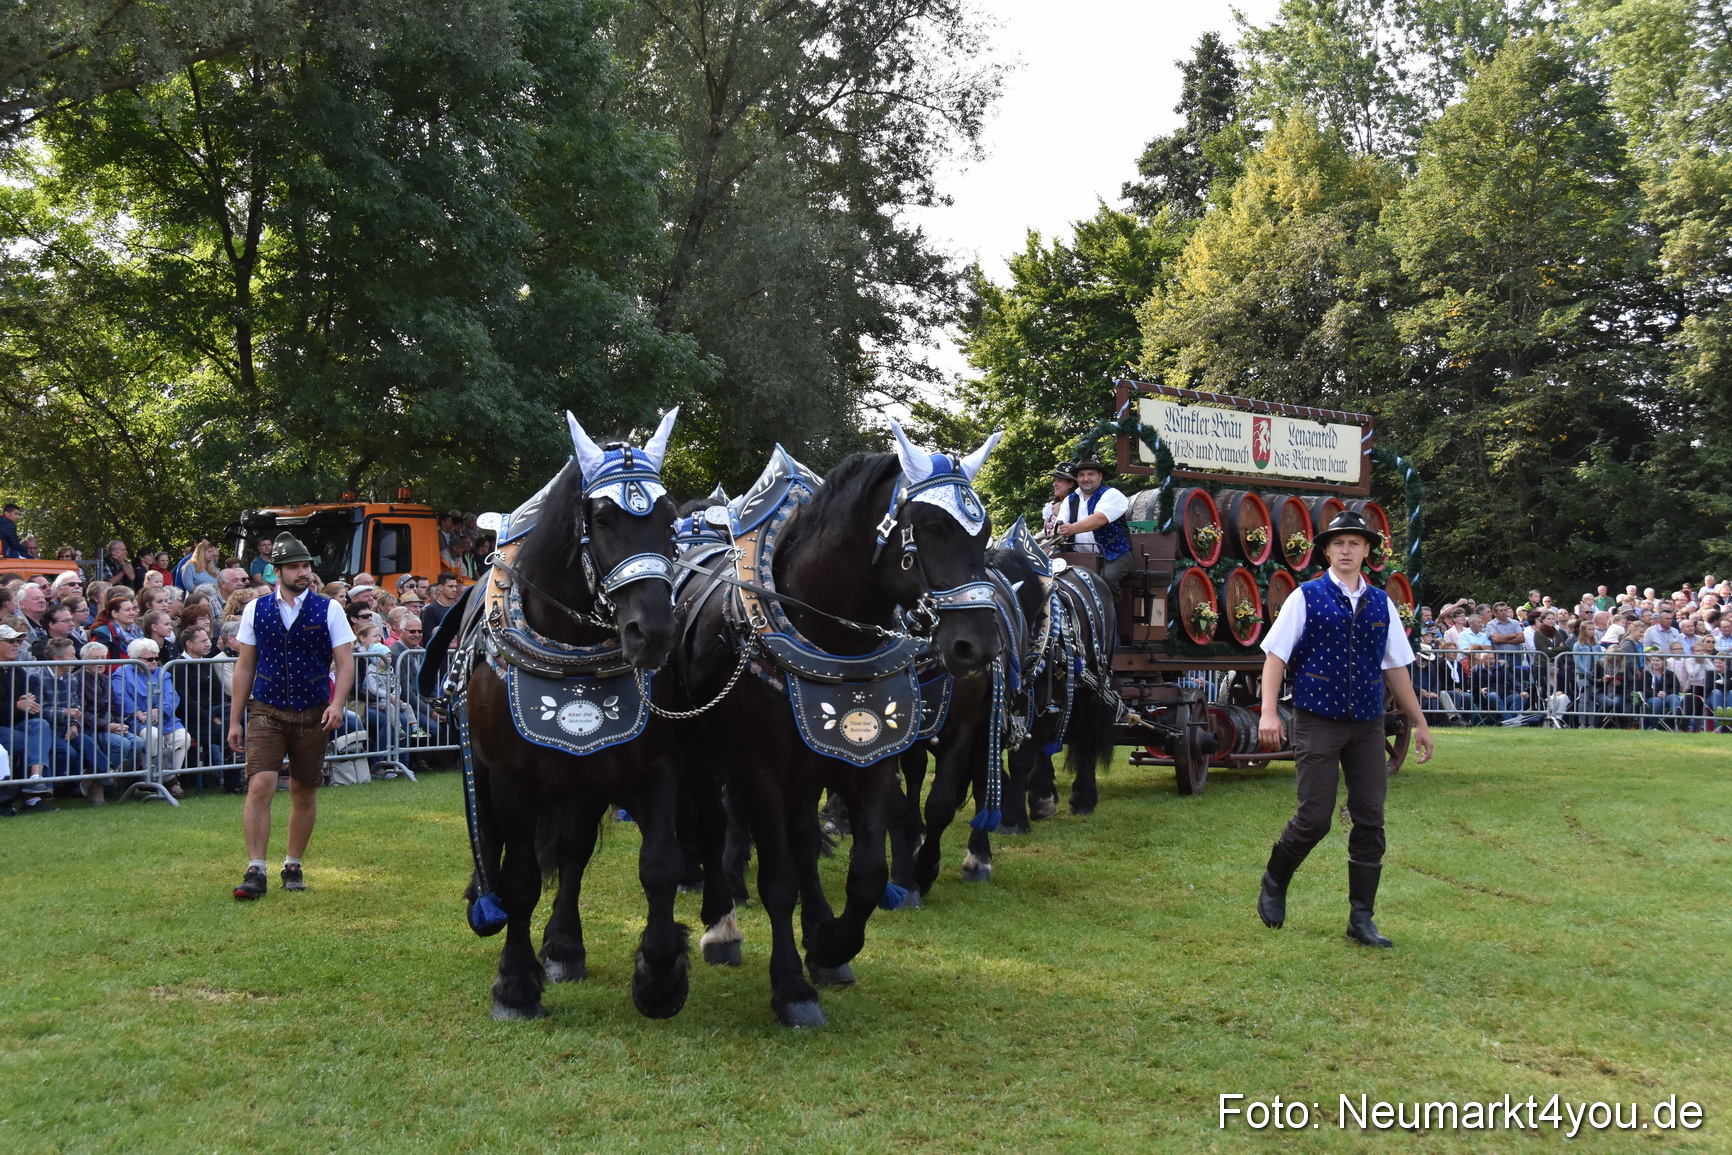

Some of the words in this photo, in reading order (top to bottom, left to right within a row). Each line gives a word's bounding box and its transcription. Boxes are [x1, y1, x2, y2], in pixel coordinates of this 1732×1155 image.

[1164, 406, 1210, 436] Winkler
[1211, 411, 1242, 439] Bräu
[1288, 421, 1338, 452] Lengenfeld
[1173, 439, 1194, 459] 1628
[1195, 441, 1214, 461] und
[1215, 443, 1249, 467] dennoch
[1274, 448, 1290, 468] das
[1292, 448, 1311, 471] Bier
[1312, 456, 1327, 472] von
[1328, 453, 1348, 474] heute
